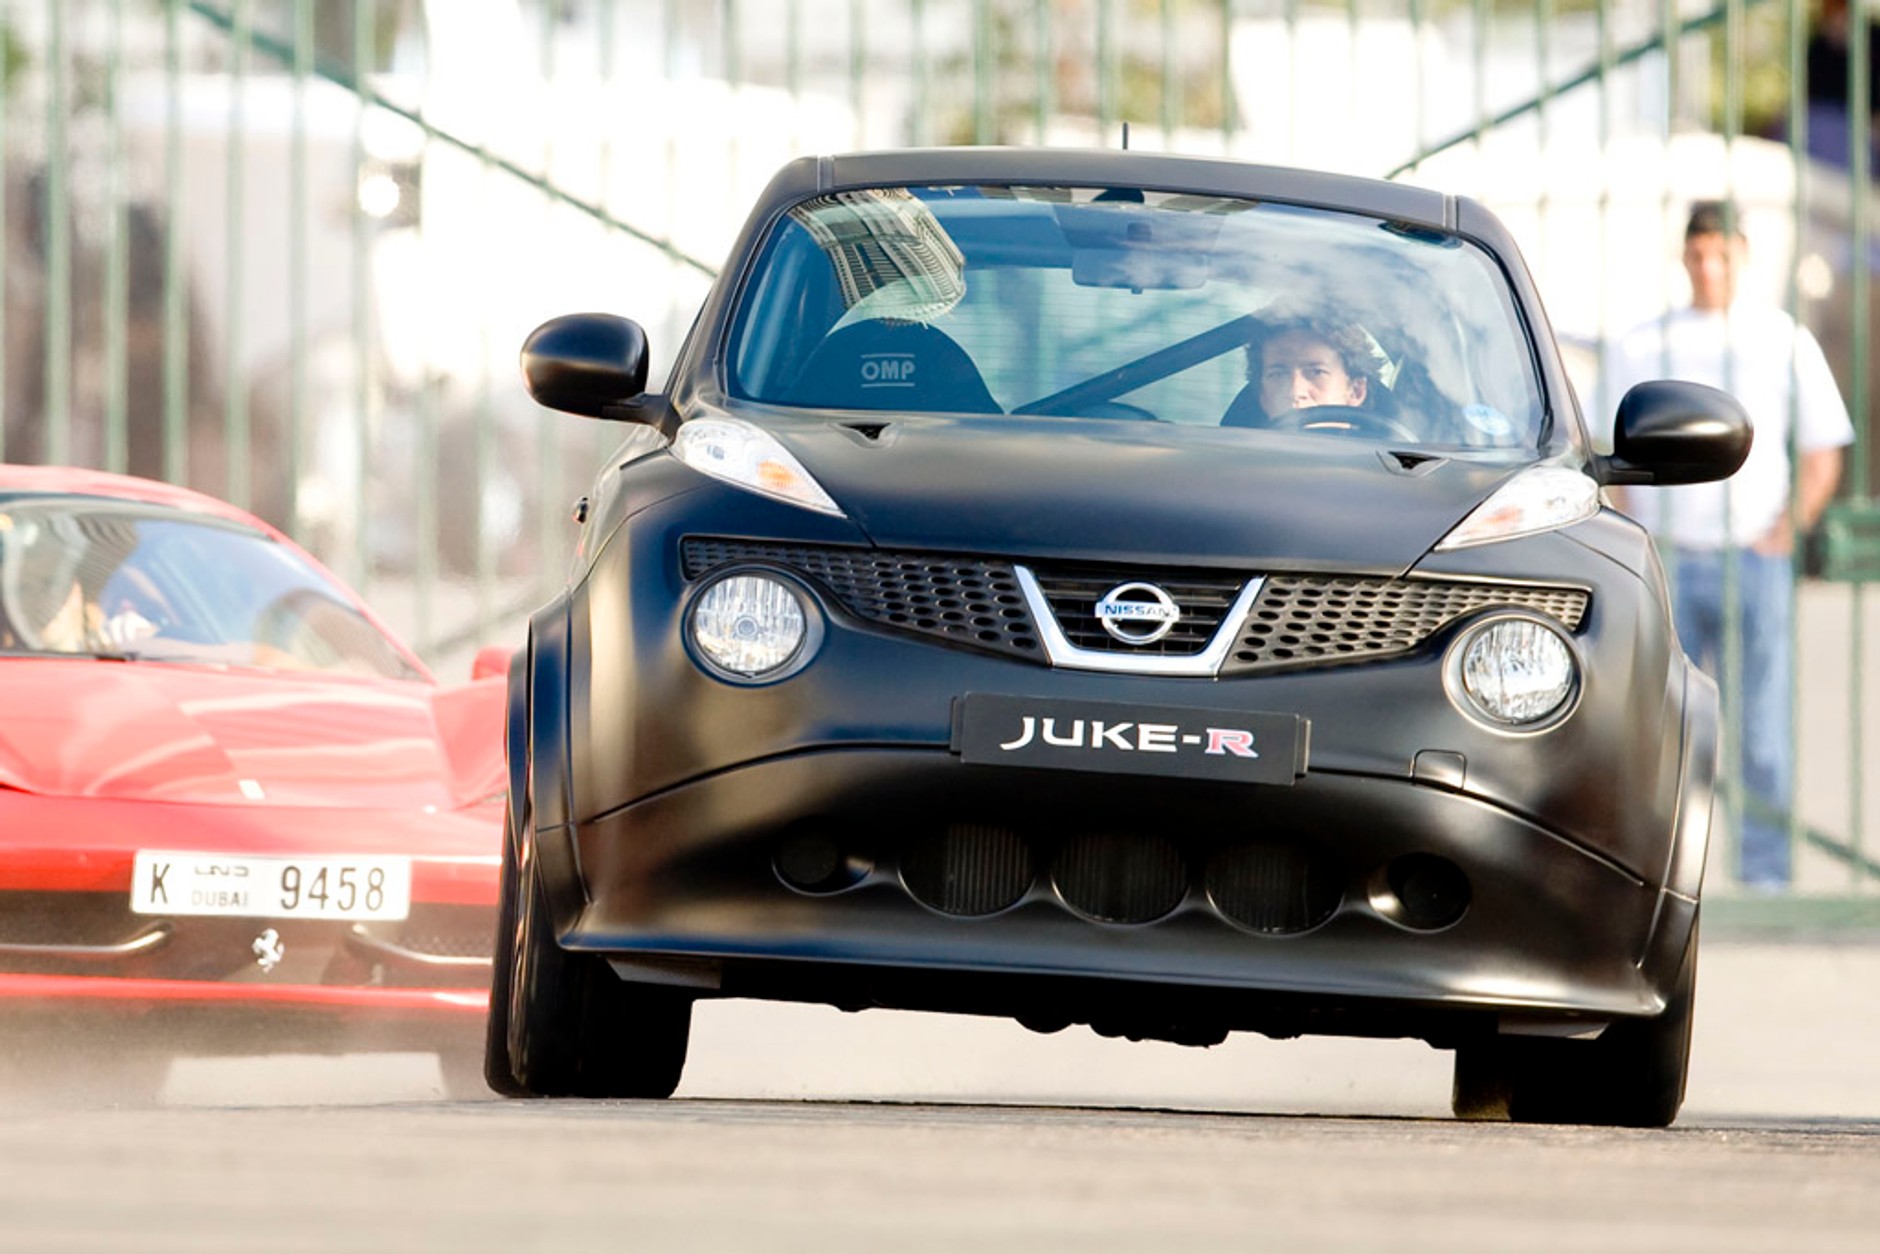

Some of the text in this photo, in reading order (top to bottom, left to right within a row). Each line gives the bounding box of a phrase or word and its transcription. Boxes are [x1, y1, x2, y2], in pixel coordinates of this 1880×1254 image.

[861, 360, 915, 381] OMP
[1105, 604, 1172, 618] NISSAN
[1000, 716, 1259, 758] JUKE-R
[150, 863, 385, 912] K 9458
[192, 889, 248, 907] DUBAI
